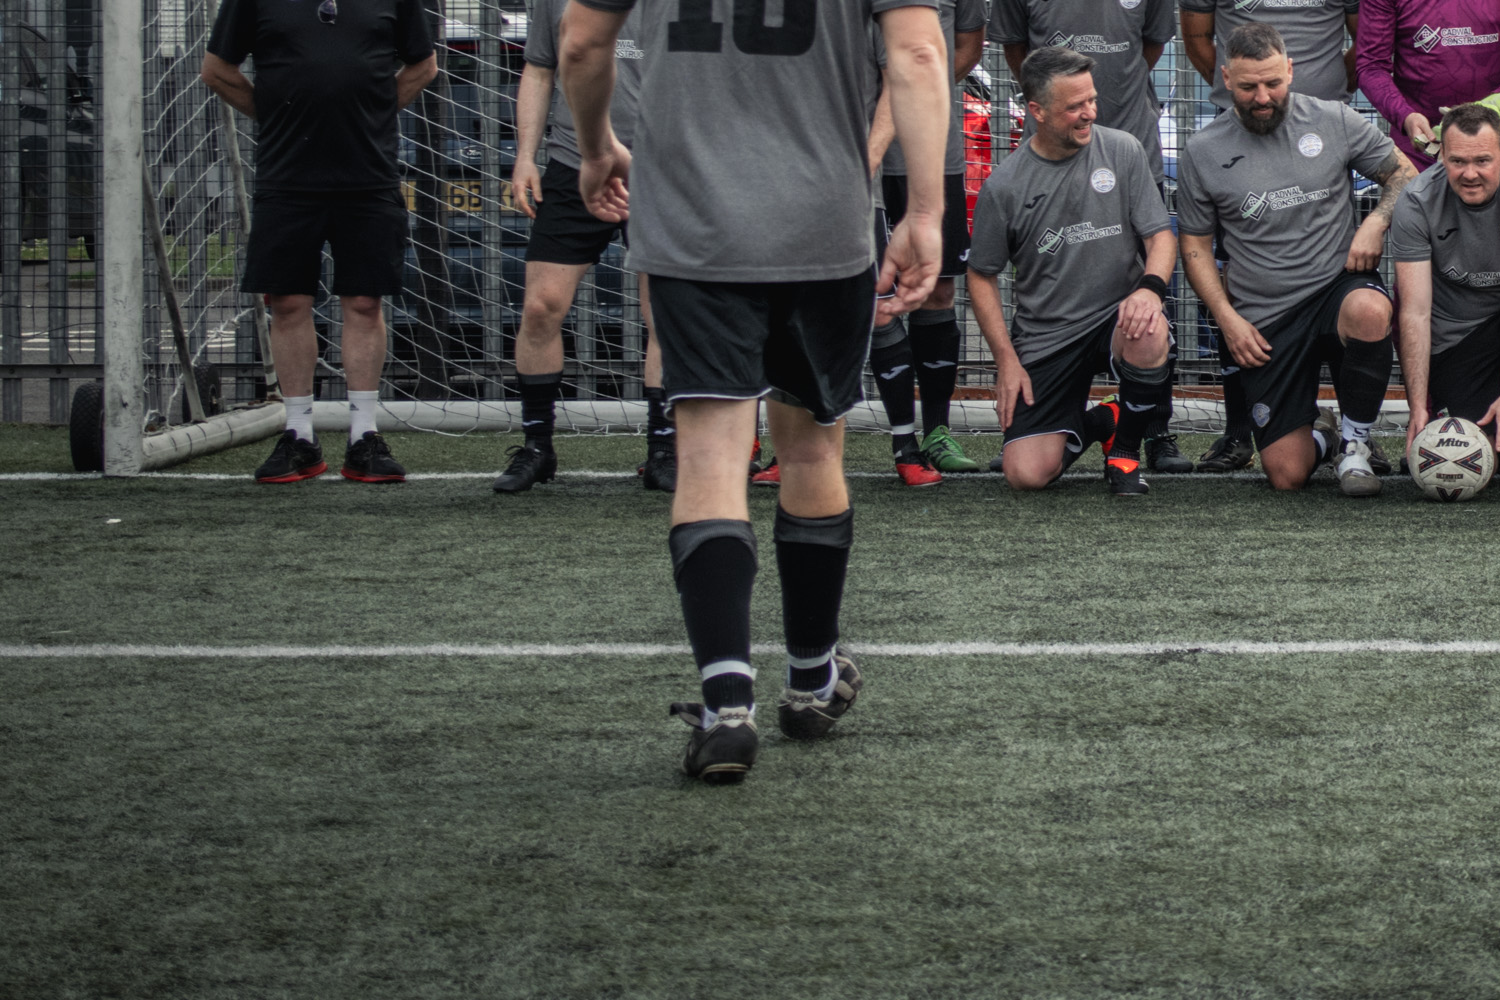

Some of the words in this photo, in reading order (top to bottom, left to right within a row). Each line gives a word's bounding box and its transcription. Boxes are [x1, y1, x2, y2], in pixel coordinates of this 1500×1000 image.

[1441, 27, 1474, 36] CADWAL
[1074, 35, 1106, 44] CADWAL
[1268, 186, 1303, 200] CADWAL
[1436, 438, 1470, 448] Mitre
